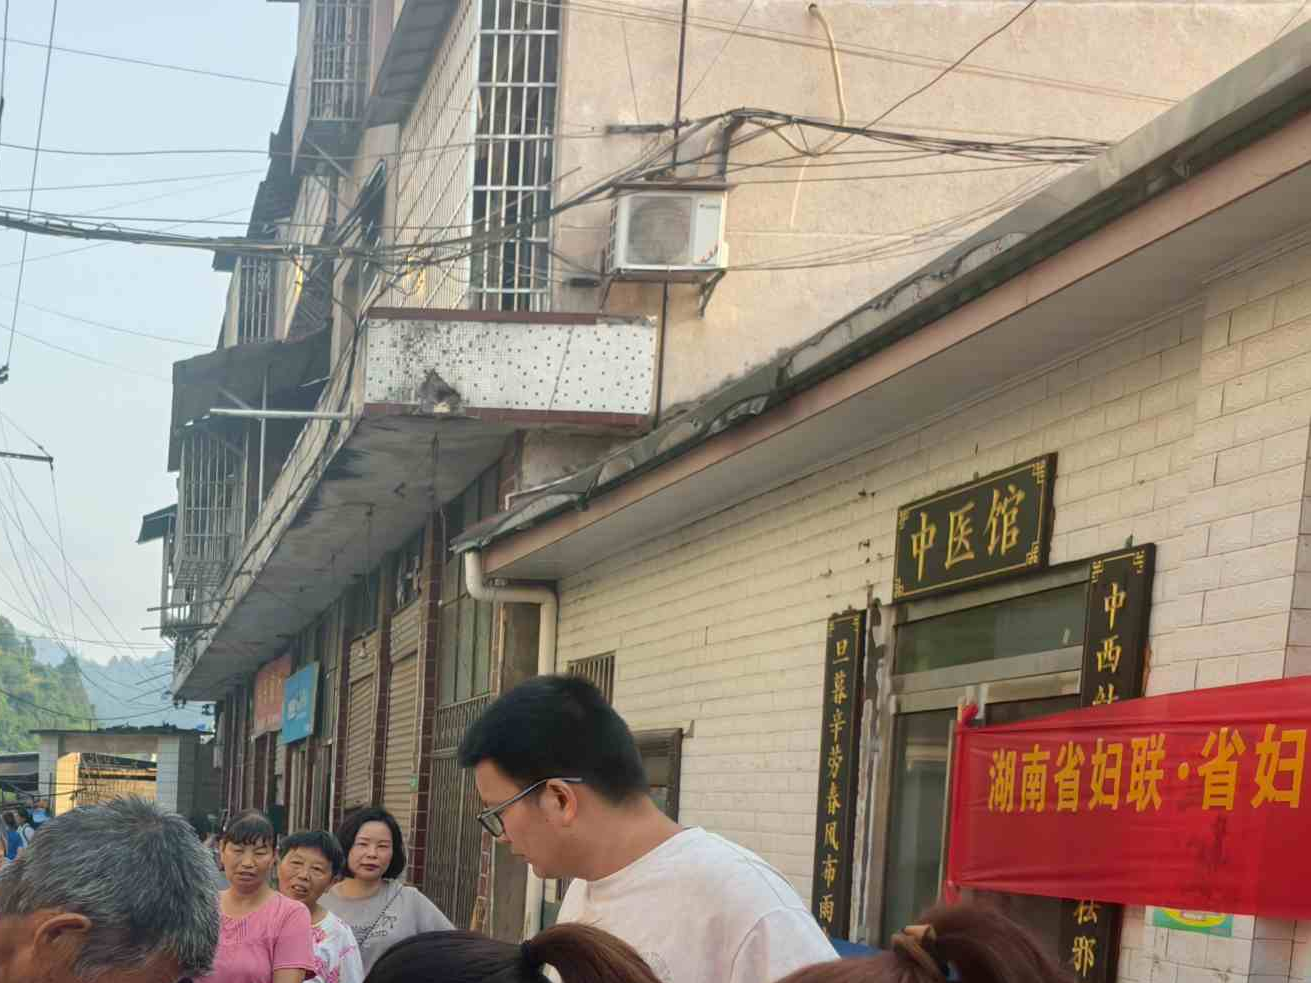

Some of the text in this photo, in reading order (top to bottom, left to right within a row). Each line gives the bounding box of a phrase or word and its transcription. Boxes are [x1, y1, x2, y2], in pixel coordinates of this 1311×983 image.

[911, 484, 1026, 581] 中医馆
[819, 638, 850, 936] 旦暮辛劳春风布雨
